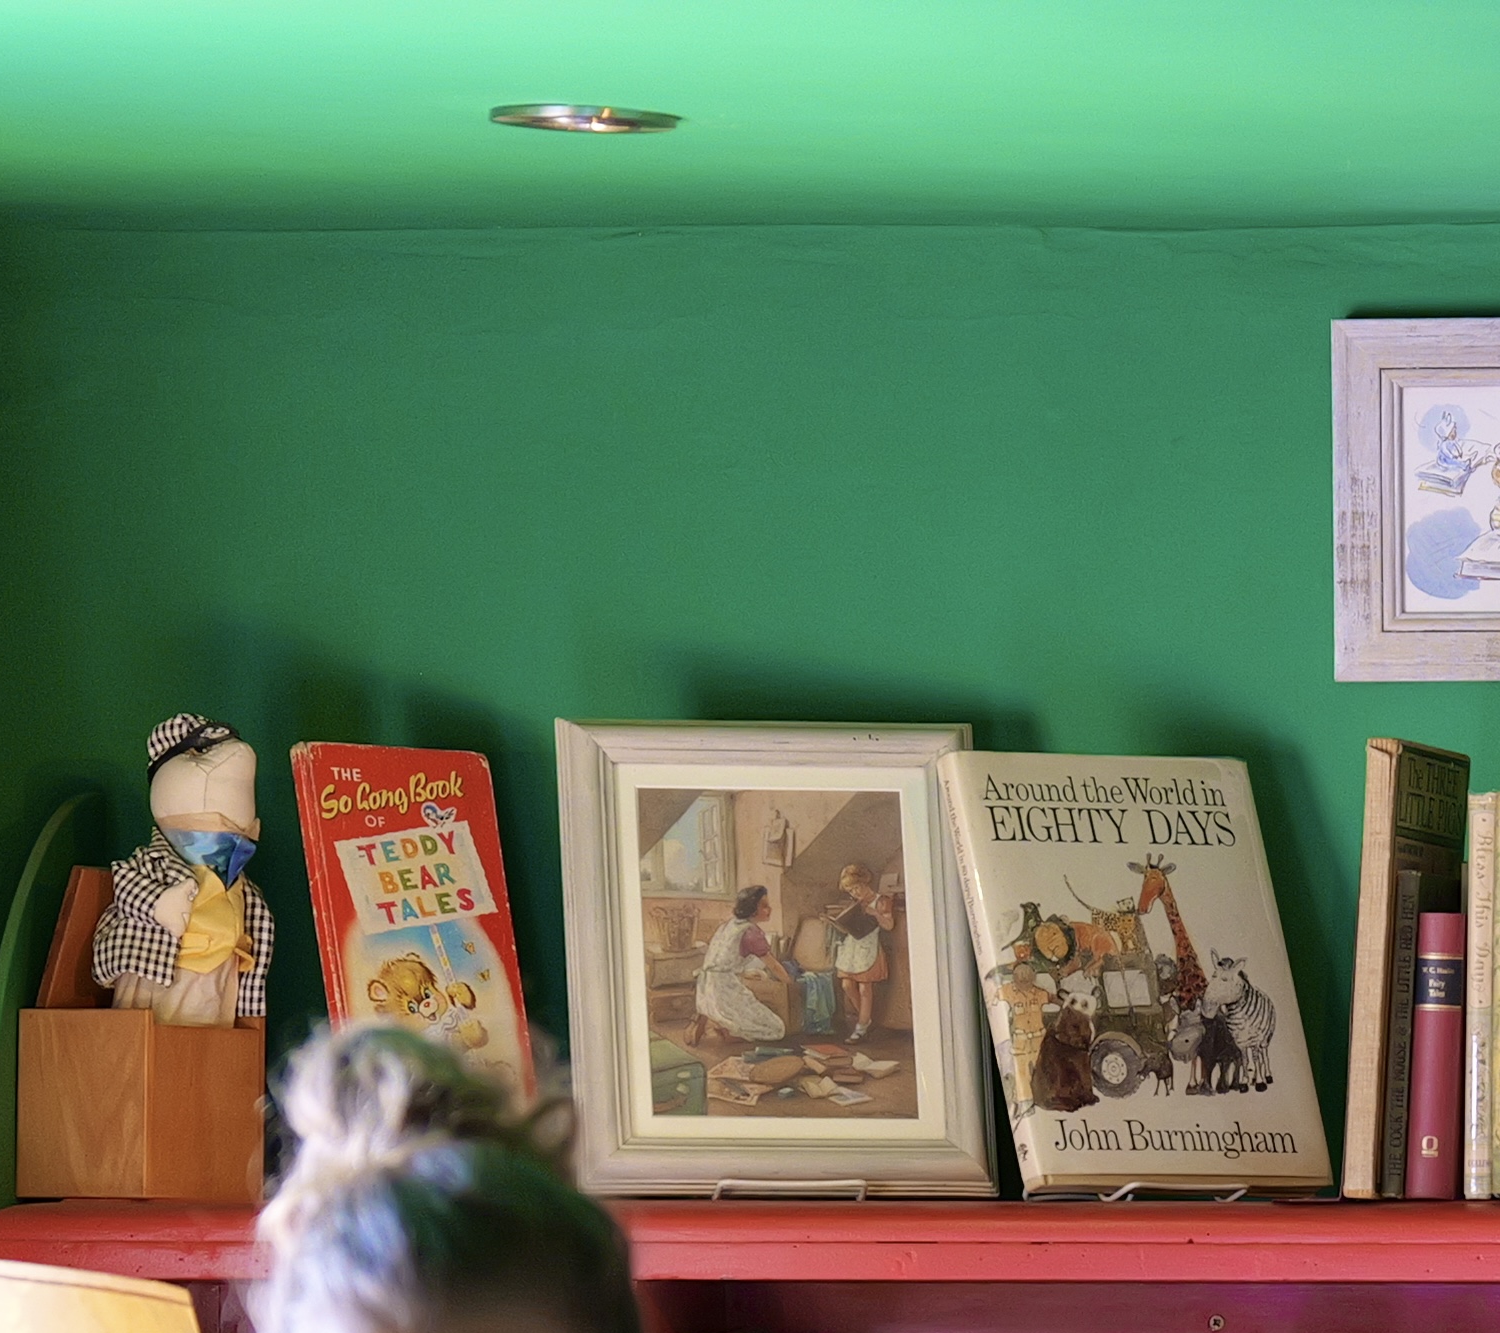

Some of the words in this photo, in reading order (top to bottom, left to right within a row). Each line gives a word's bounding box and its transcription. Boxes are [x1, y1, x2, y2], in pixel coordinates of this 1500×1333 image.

[330, 766, 362, 782] THE
[982, 773, 1076, 803] Around
[1082, 778, 1123, 804] the
[1123, 776, 1196, 805] World
[1201, 779, 1225, 806] in
[320, 784, 351, 821] So
[410, 770, 464, 805] Book
[364, 815, 387, 829] OF
[990, 805, 1128, 843] EIGHTY
[1149, 809, 1236, 847] DAYS
[357, 828, 457, 867] TEDDY
[380, 862, 457, 895] BEAR
[377, 887, 475, 925] TALES
[1054, 1119, 1118, 1152] John
[1125, 1119, 1298, 1159] Burningham
